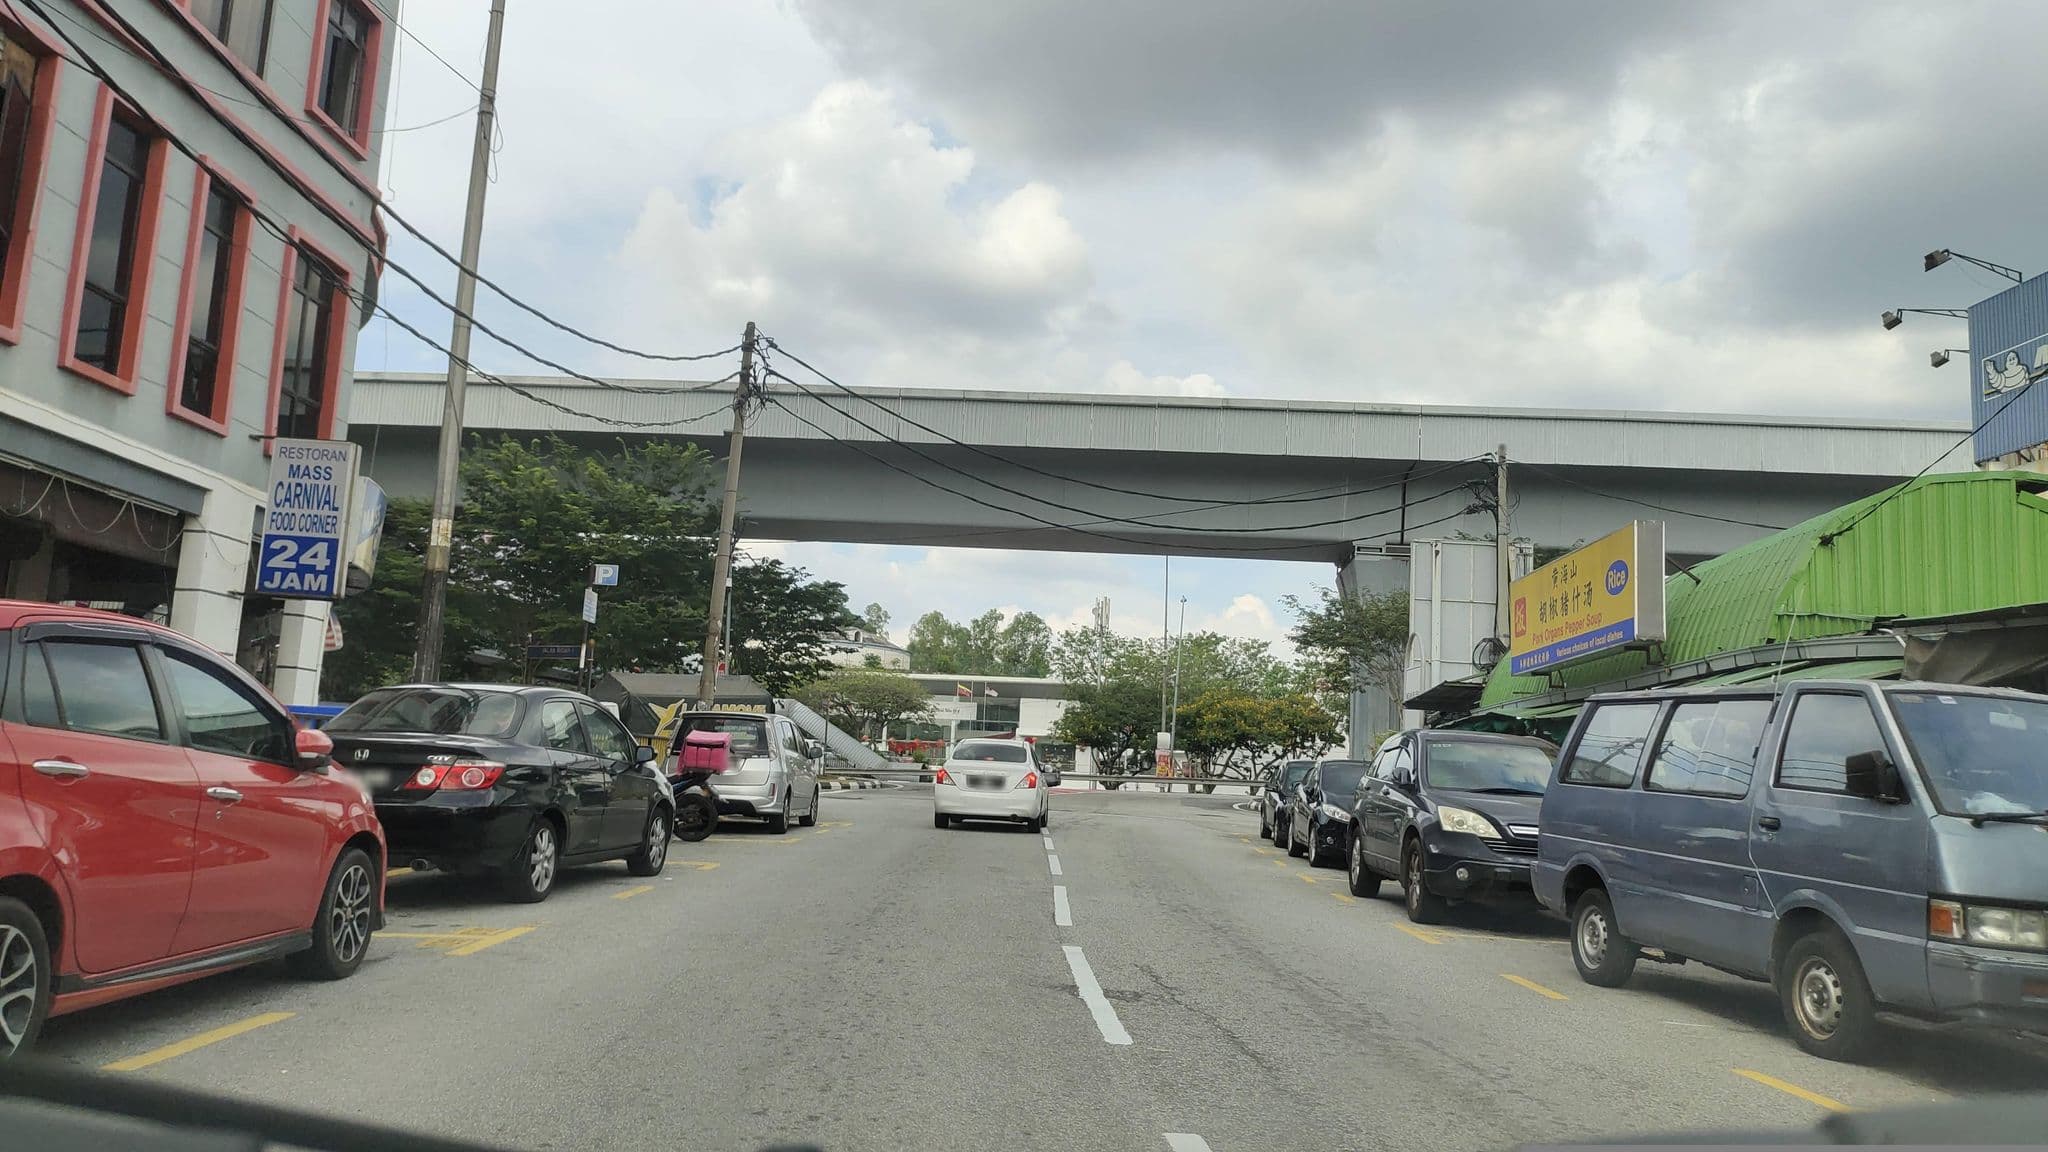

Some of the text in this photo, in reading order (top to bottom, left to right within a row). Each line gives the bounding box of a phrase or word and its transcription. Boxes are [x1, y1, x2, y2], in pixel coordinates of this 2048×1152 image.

[279, 446, 347, 462] RESTORAN
[288, 464, 333, 481] MASS
[274, 482, 339, 512] CARNIVAL
[269, 511, 338, 534] FOOD CORNER
[266, 539, 331, 571] 24
[264, 572, 328, 592] JAM
[599, 566, 614, 584] P
[1608, 568, 1626, 589] Rice
[1564, 618, 1585, 635] Pepper
[1586, 613, 1603, 628] Soup
